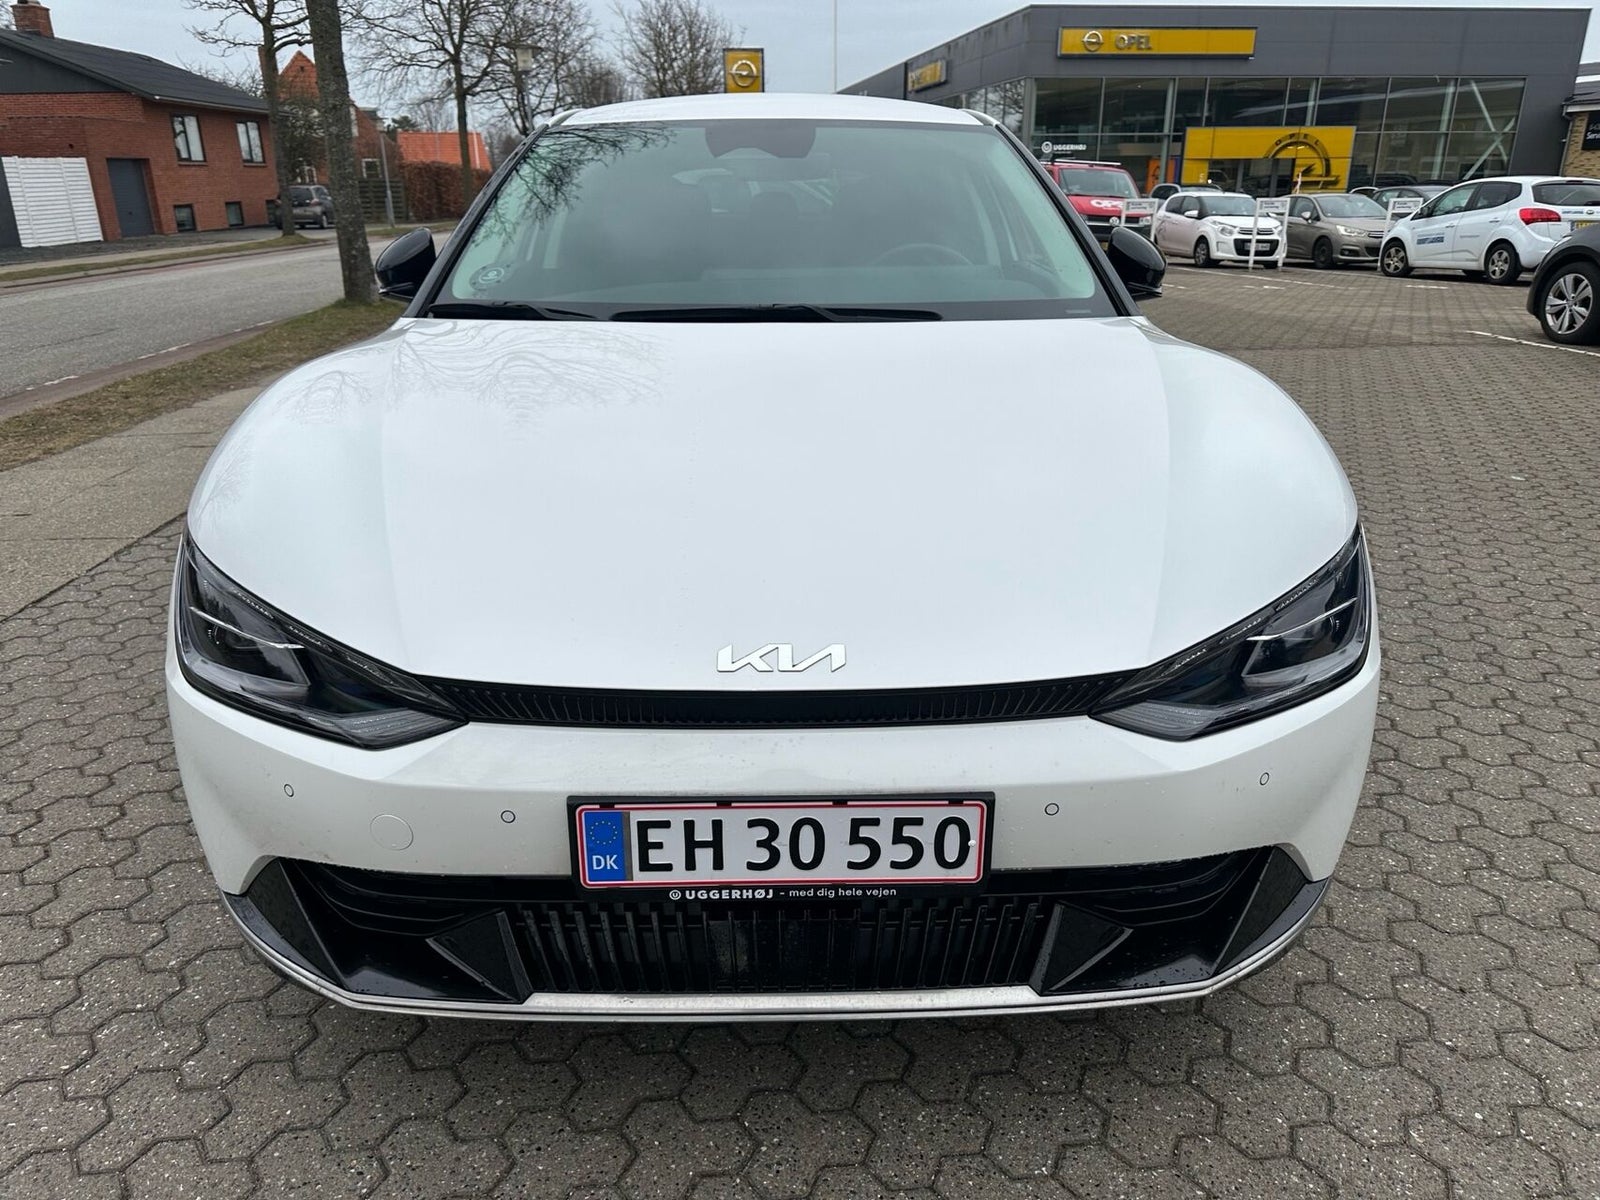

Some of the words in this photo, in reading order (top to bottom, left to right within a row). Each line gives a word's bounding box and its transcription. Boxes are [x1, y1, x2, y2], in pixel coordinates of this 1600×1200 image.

[1115, 34, 1152, 50] OPEL
[717, 643, 847, 673] KIA
[636, 819, 725, 872] EH
[746, 817, 826, 871] 30
[846, 816, 971, 870] 550
[592, 854, 619, 870] DK
[685, 888, 773, 900] UGGERHØJ
[789, 887, 814, 898] med
[816, 888, 835, 899] dig
[838, 887, 863, 897] hele
[865, 887, 897, 898] vejen
